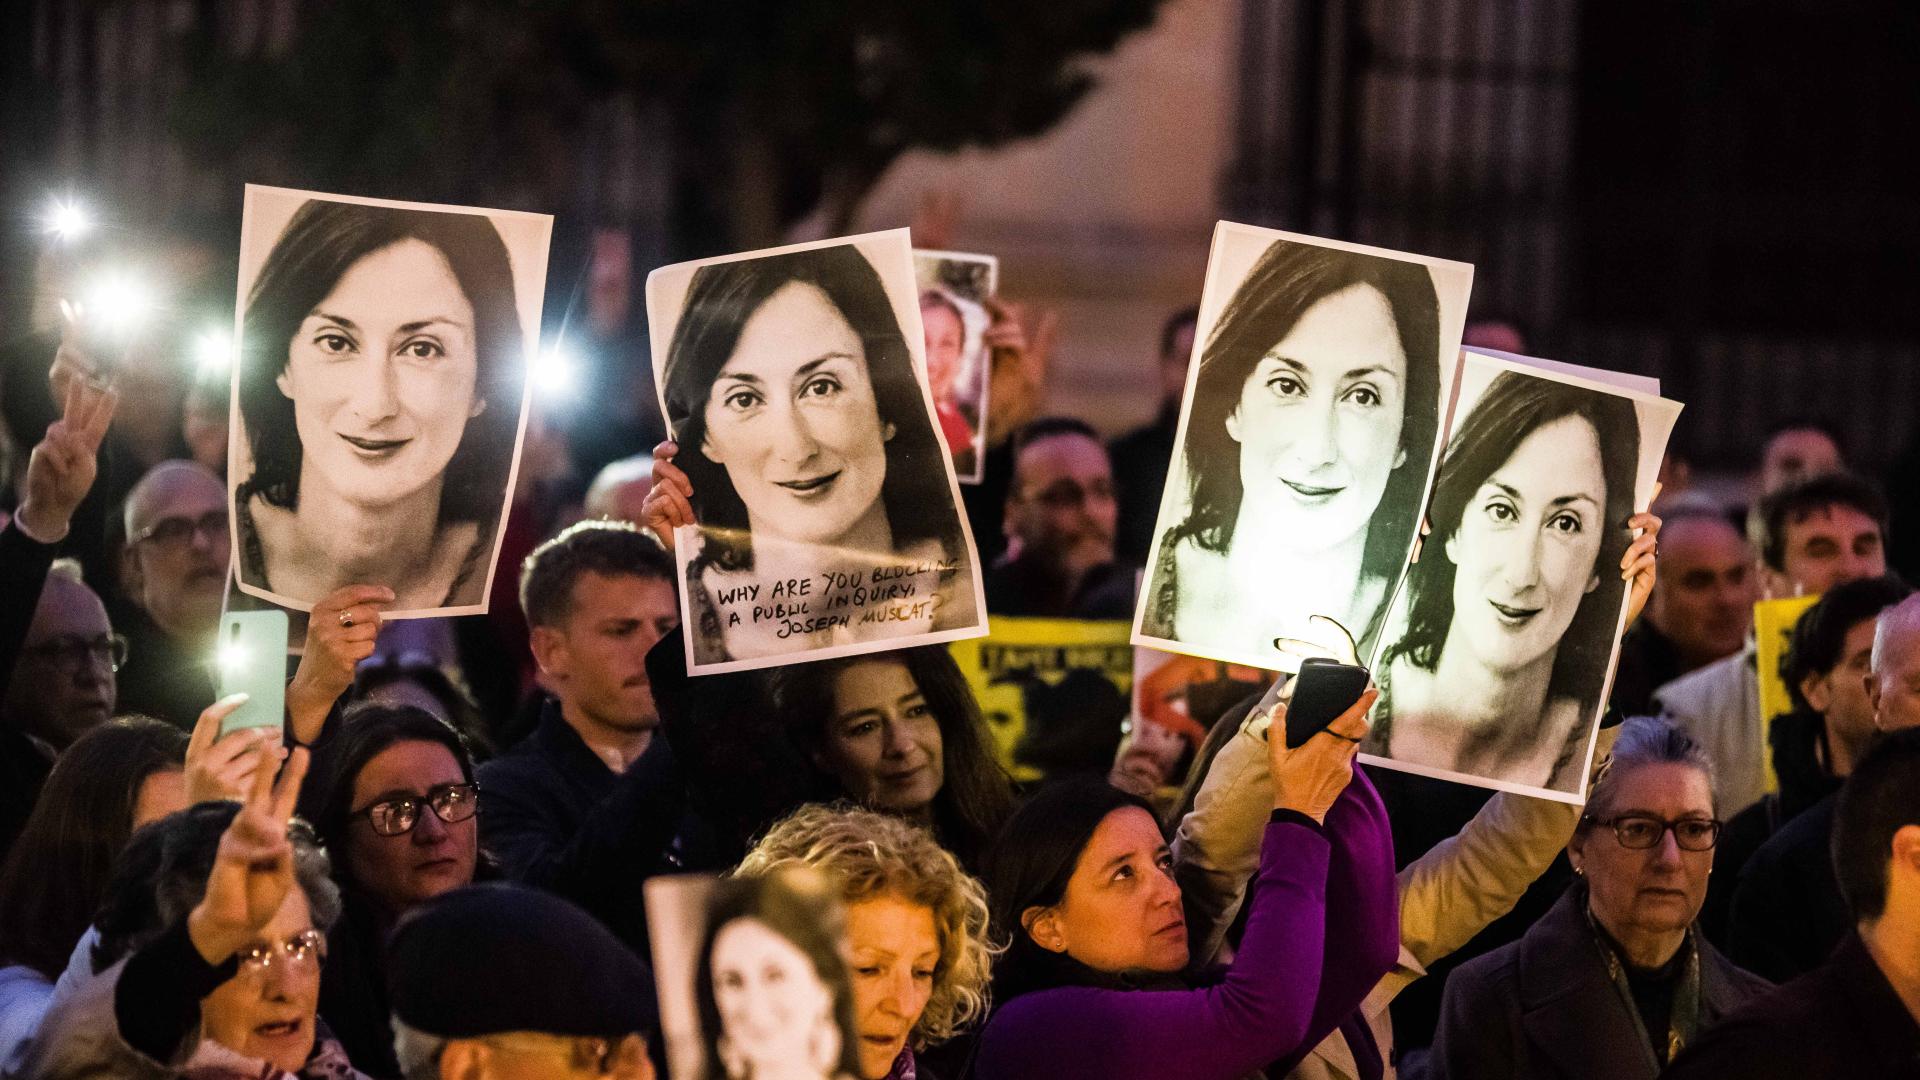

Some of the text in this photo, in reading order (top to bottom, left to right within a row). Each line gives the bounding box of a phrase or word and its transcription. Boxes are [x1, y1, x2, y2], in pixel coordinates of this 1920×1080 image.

[718, 585, 760, 605] WHY
[772, 578, 811, 599] ARE
[822, 571, 862, 596] YOU
[728, 611, 741, 628] A
[753, 602, 810, 623] PUBLIC
[777, 593, 944, 639] JOSEPH MUSCAT?
